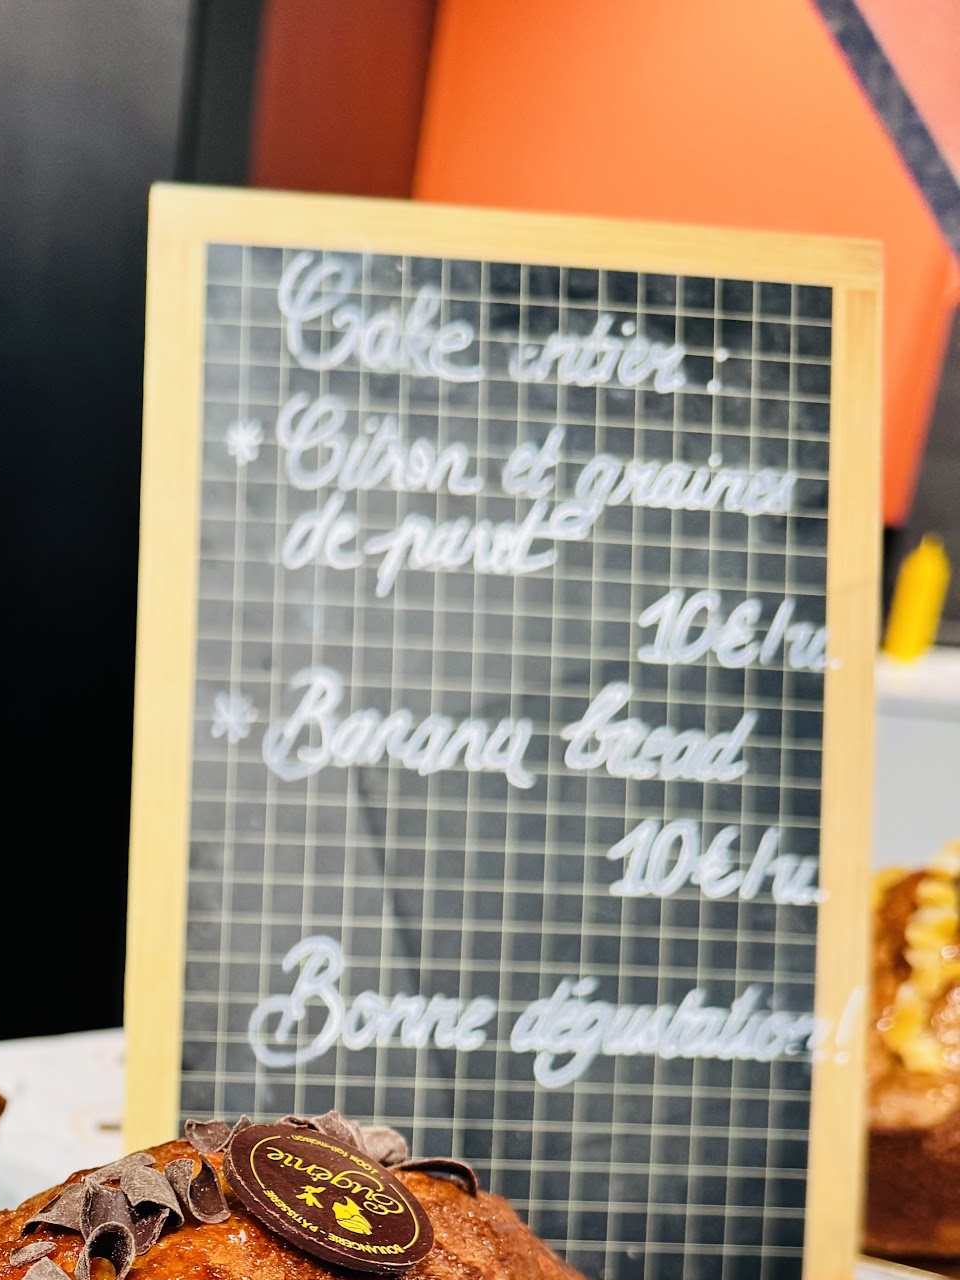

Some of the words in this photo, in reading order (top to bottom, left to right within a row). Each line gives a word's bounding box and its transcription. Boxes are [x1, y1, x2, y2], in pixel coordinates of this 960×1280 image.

[278, 251, 485, 382] Cake
[276, 392, 484, 496] Citron
[502, 424, 566, 499] et
[549, 452, 798, 540] graines
[282, 488, 364, 570] de
[262, 665, 536, 789] Banana
[562, 681, 759, 782] bread
[248, 935, 497, 1068] Bonne
[266, 1147, 404, 1215] Eugénie
[328, 1234, 405, 1255] BOULANGERIE
